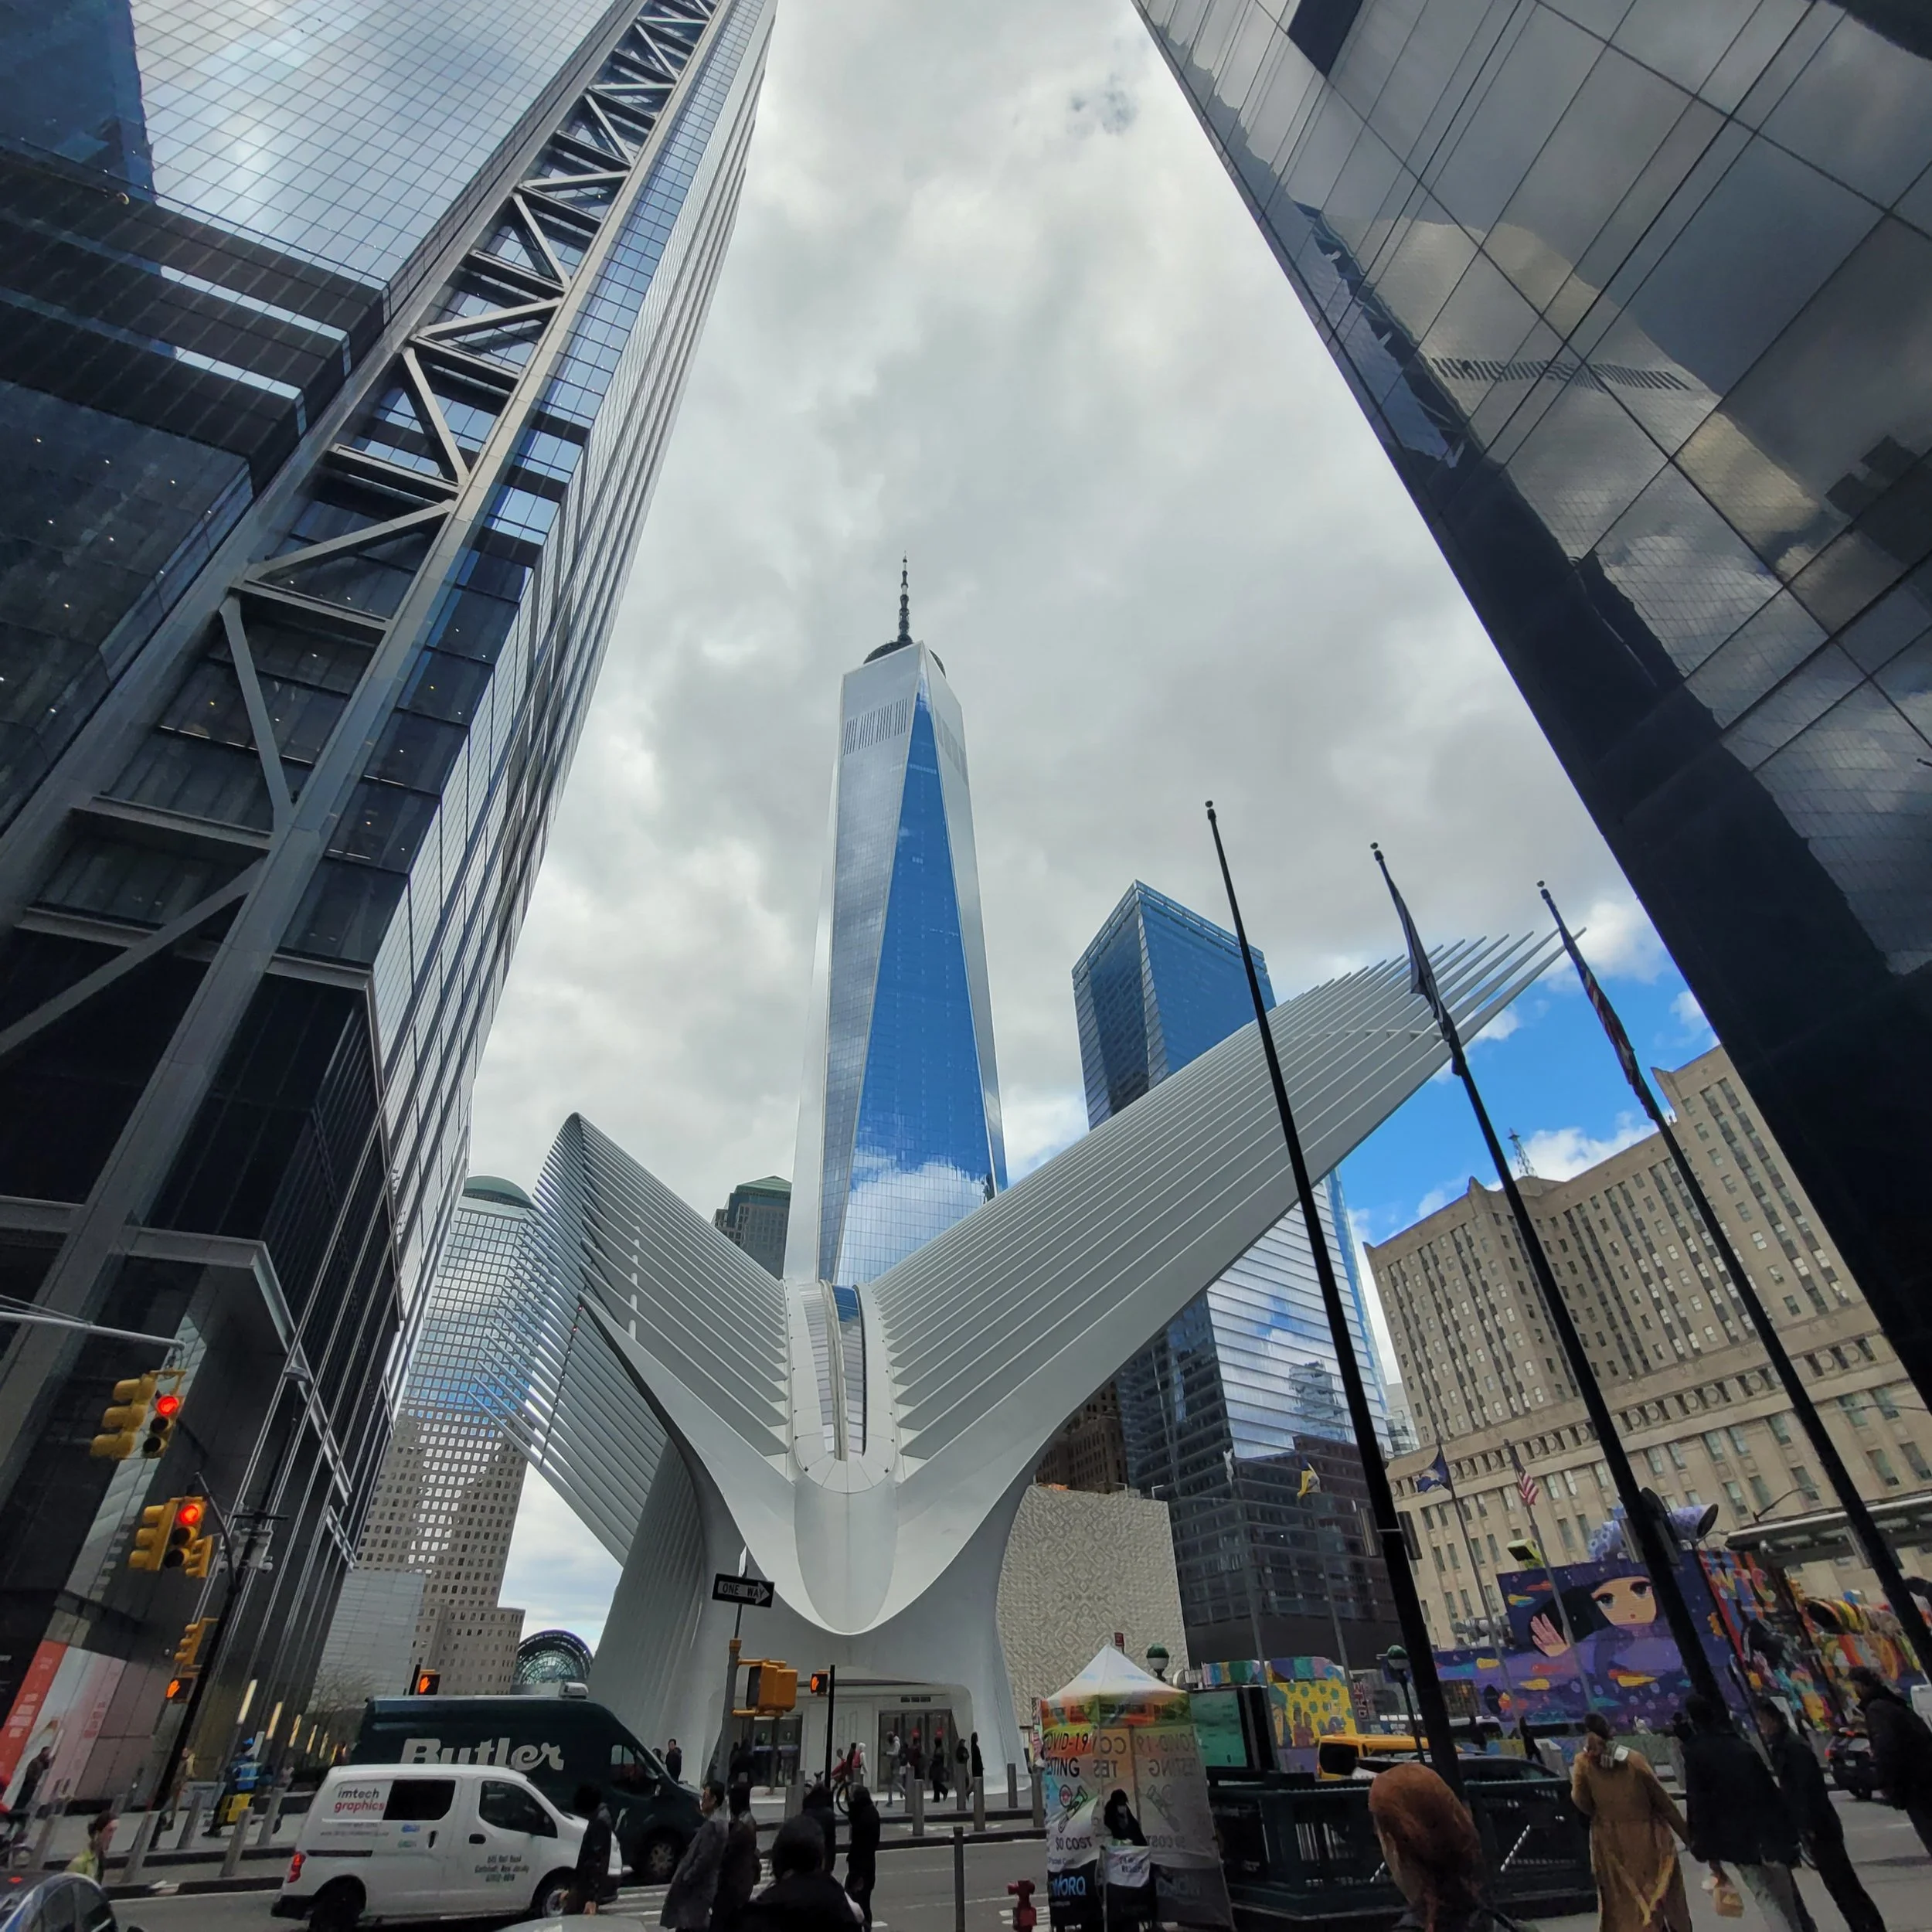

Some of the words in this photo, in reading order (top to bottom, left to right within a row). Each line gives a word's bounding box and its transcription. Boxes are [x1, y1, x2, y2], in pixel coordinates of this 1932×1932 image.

[723, 1583, 740, 1595] ONE
[747, 1586, 765, 1599] WAY
[1709, 1566, 1776, 1603] WTC
[400, 1737, 564, 1770] Butler
[338, 1787, 379, 1799] imtech
[334, 1800, 385, 1813] graphics
[1066, 1835, 1092, 1850] COST
